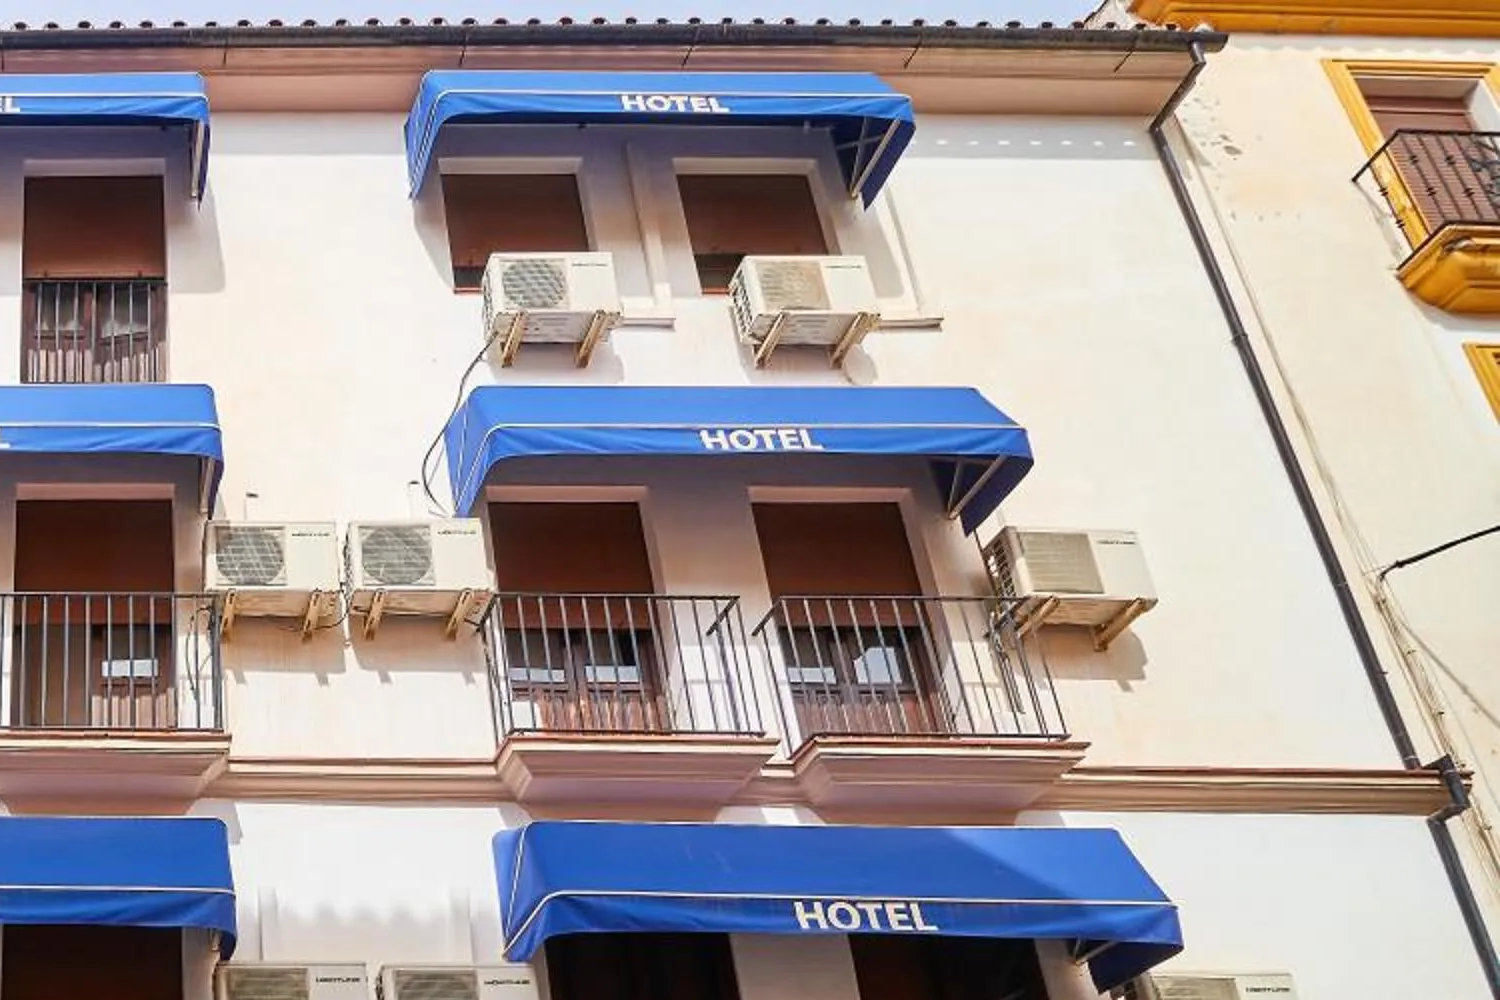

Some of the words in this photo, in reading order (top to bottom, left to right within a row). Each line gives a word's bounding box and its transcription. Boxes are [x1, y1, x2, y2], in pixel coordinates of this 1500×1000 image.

[620, 94, 731, 113] HOTEL
[699, 429, 825, 451] HOTEL
[793, 901, 940, 931] HOTEL
